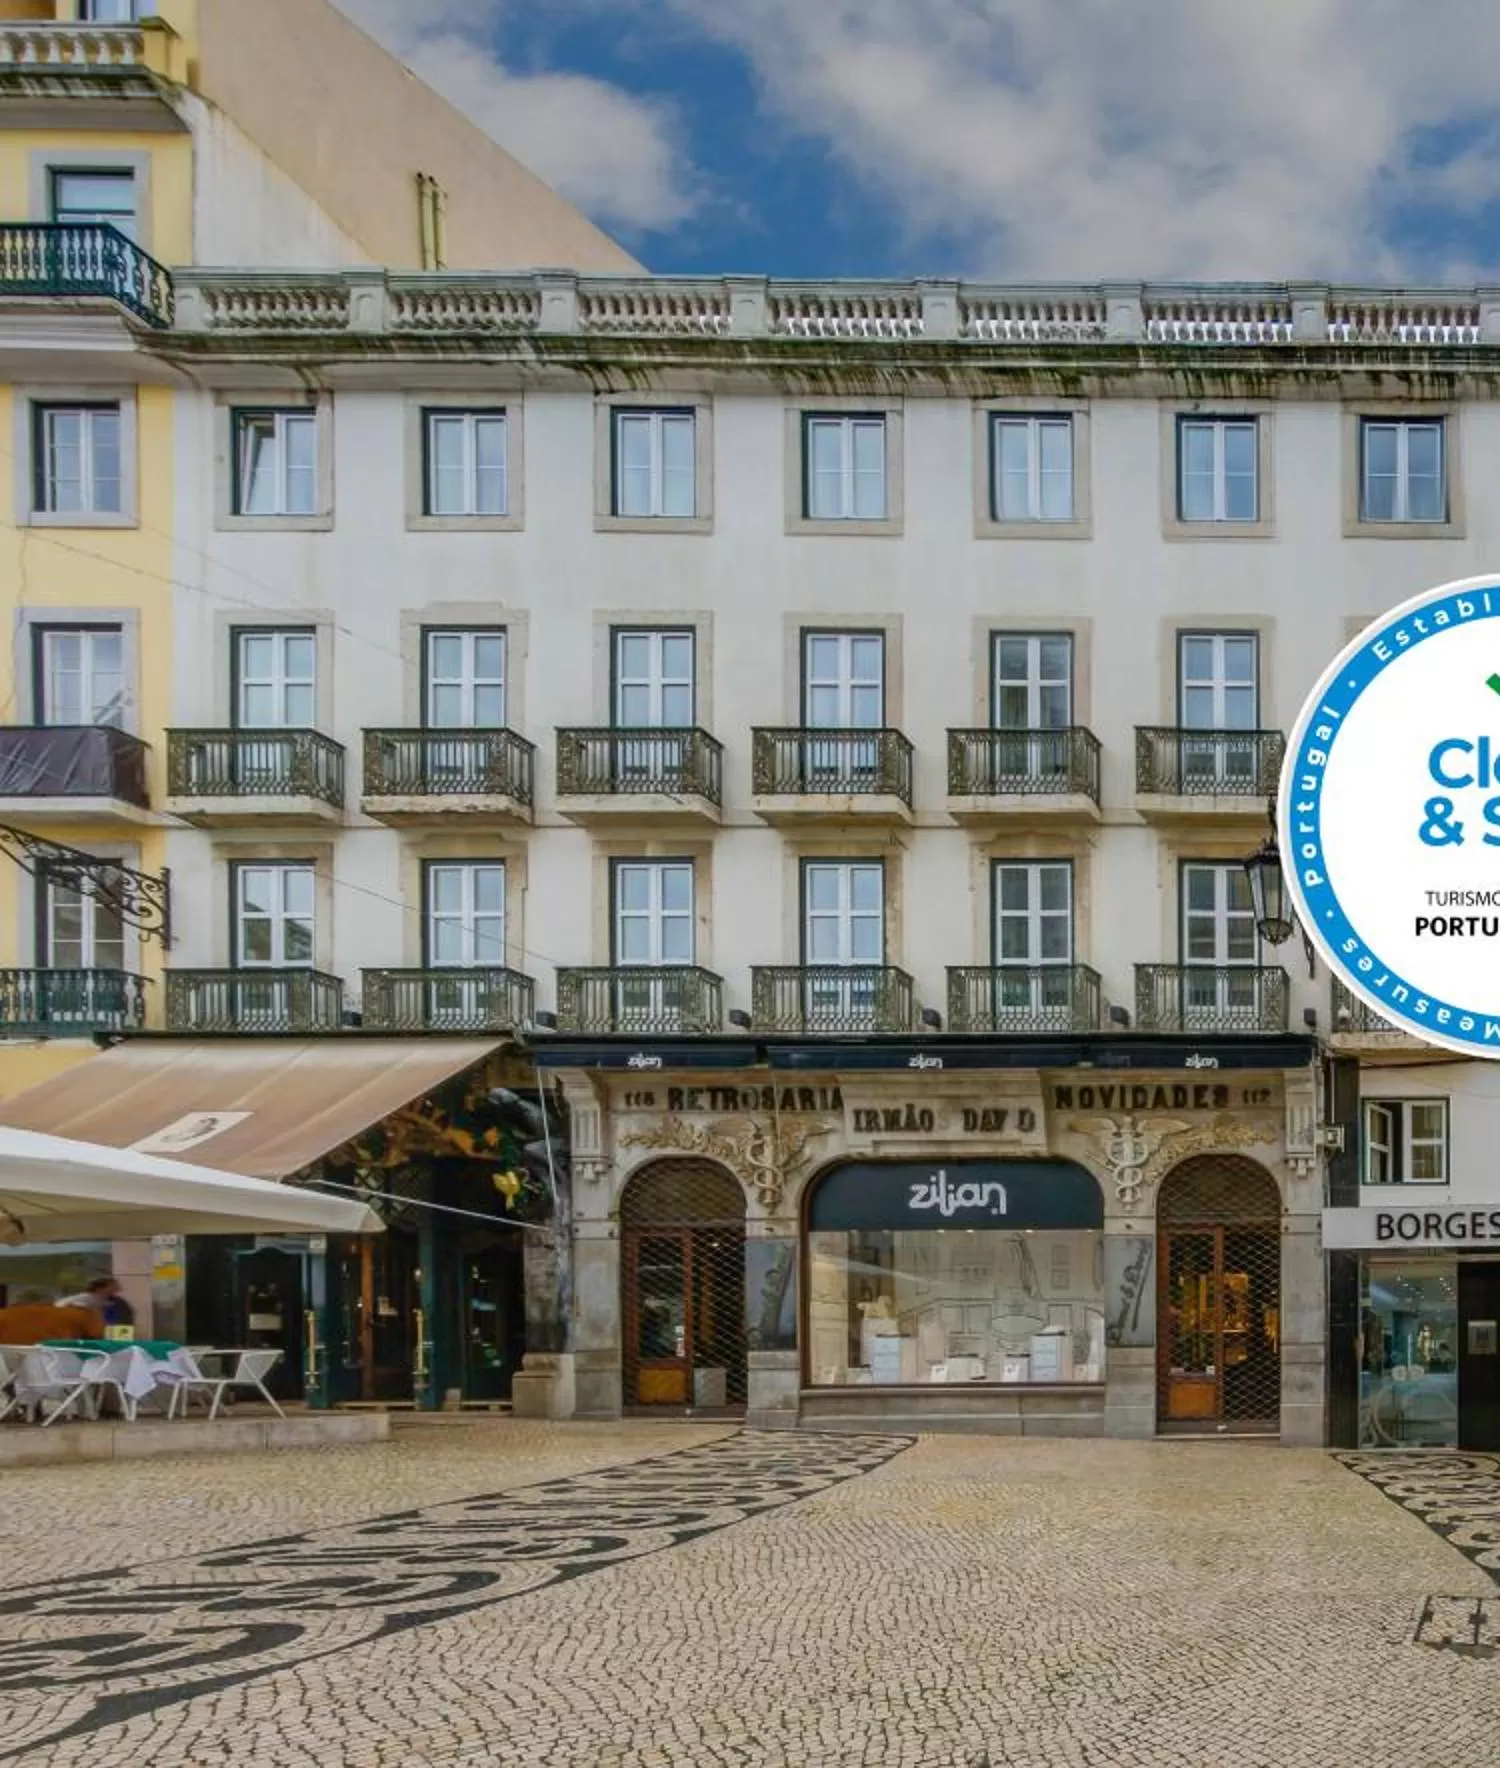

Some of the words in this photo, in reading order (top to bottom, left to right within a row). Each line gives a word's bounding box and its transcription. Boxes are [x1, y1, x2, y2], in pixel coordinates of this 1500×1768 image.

[668, 1086, 844, 1111] RETROSARIA
[1055, 1085, 1229, 1109] NOVIDADES
[853, 1104, 950, 1133] IRMÃO
[962, 1108, 1036, 1133] DAVD
[908, 1169, 1007, 1217] zilian
